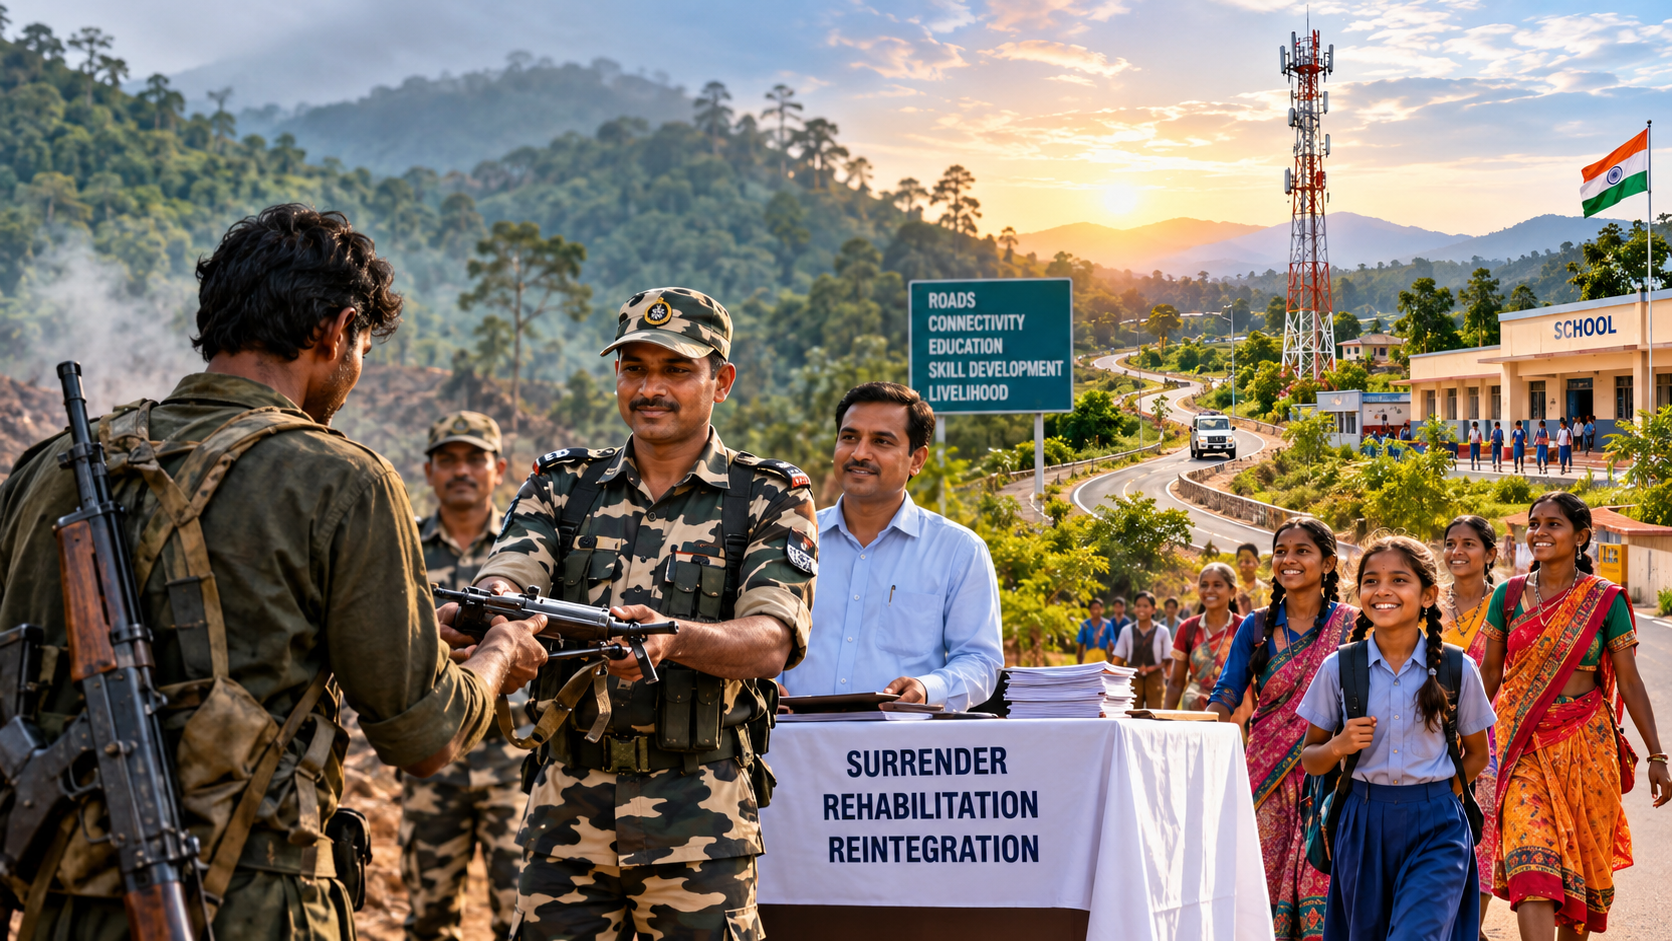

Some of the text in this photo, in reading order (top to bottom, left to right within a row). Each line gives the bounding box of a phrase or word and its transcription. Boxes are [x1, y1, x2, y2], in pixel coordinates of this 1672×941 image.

[929, 292, 976, 309] ROADS
[928, 314, 1025, 332] CONNECTIVITY
[1554, 315, 1617, 340] SCHOOL
[928, 338, 1003, 355] EDUCATION
[928, 360, 1064, 378] SKILL DEVELOPMENT
[928, 384, 1009, 401] LIVELIHOOD
[846, 747, 1008, 777] SURRENDER
[823, 790, 1039, 820] REHABILITATION
[828, 835, 1039, 863] REINTEGRATION
